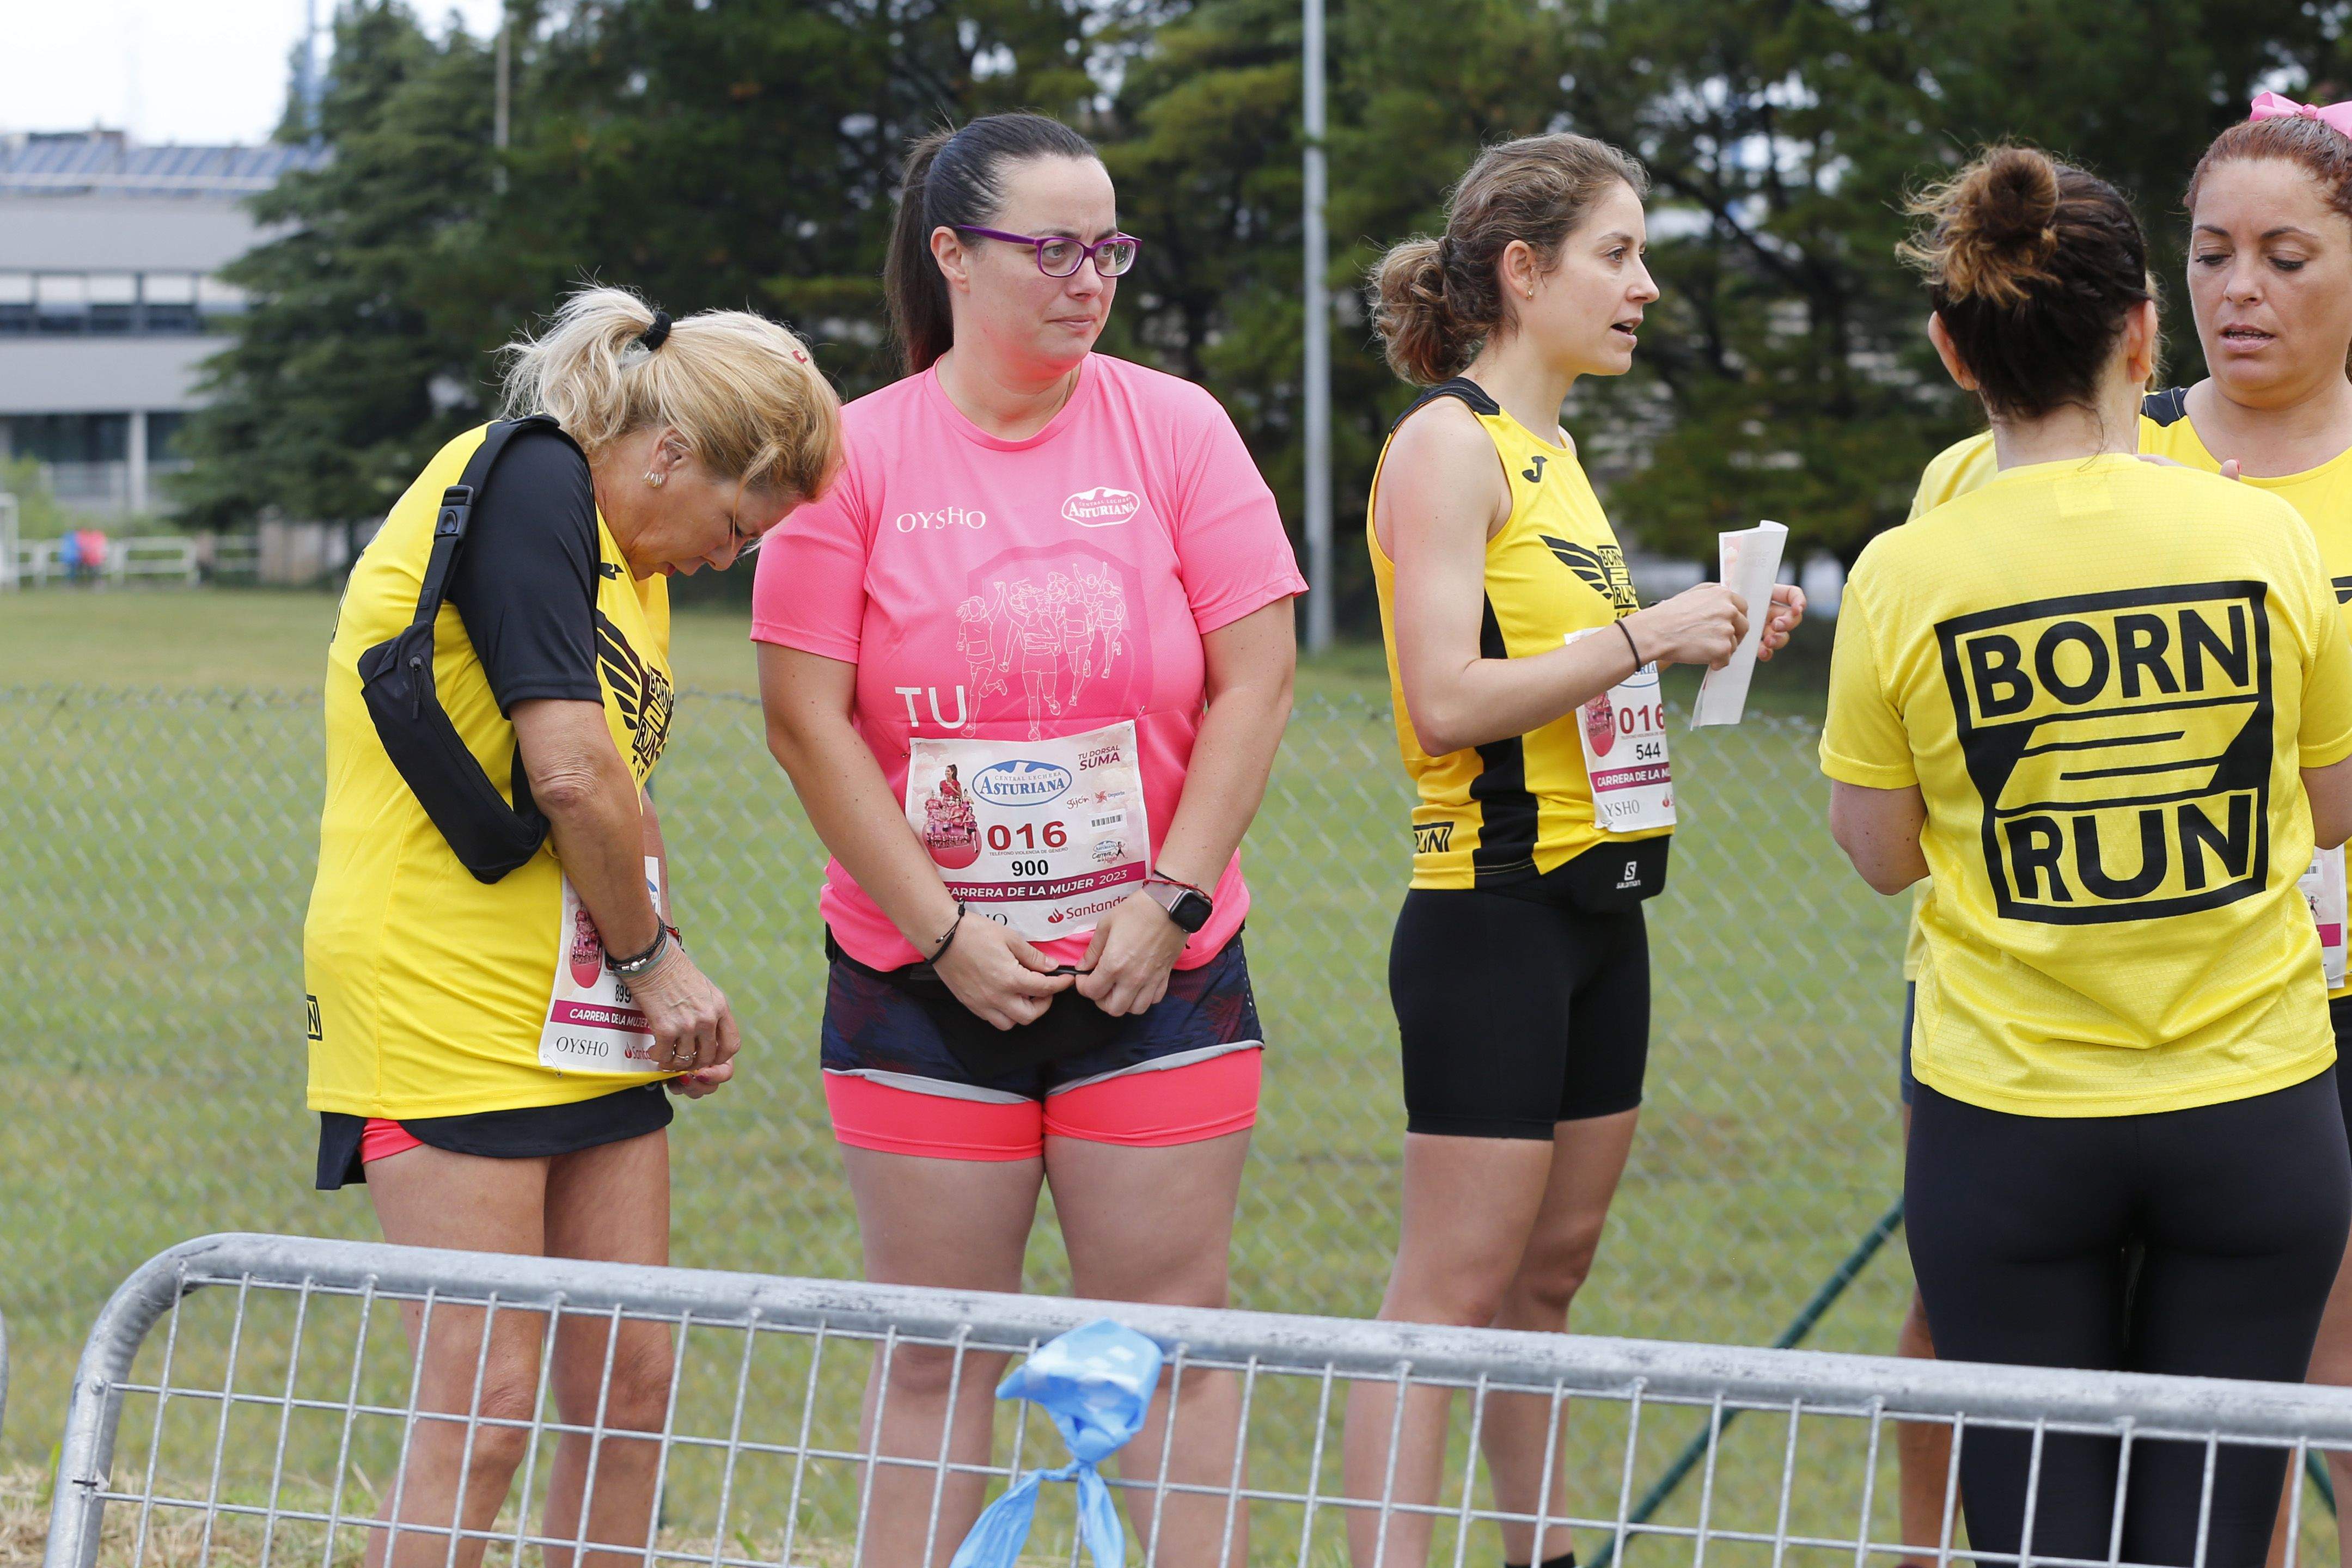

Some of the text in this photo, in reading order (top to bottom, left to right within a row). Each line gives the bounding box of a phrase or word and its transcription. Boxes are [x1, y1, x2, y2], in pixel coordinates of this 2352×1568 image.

[1068, 501, 1135, 518] ASTURIANA
[896, 506, 986, 533] OYSHO
[1966, 605, 2250, 719] BORN
[895, 685, 967, 728] TU
[1090, 745, 1120, 757] DORSAL
[1636, 742, 1660, 760] 544
[1079, 752, 1120, 770] SUMA
[1028, 771, 1061, 780] LECHERA
[1597, 773, 1634, 787] CARRERA
[1635, 770, 1646, 782] DE
[1648, 769, 1660, 780] LA
[980, 776, 1065, 795] ASTURIANA
[1604, 799, 1640, 817] YSHO
[987, 821, 1067, 850] 016
[2004, 794, 2252, 902] RUN
[1012, 860, 1048, 877] 900
[947, 869, 1127, 897] ARRERA DE LA MUJER 2023
[1066, 896, 1127, 919] Santand
[615, 984, 632, 1003] 899
[570, 1008, 609, 1023] CARRERA
[627, 1016, 647, 1028] MUJER
[557, 1036, 609, 1057] OYSHO
